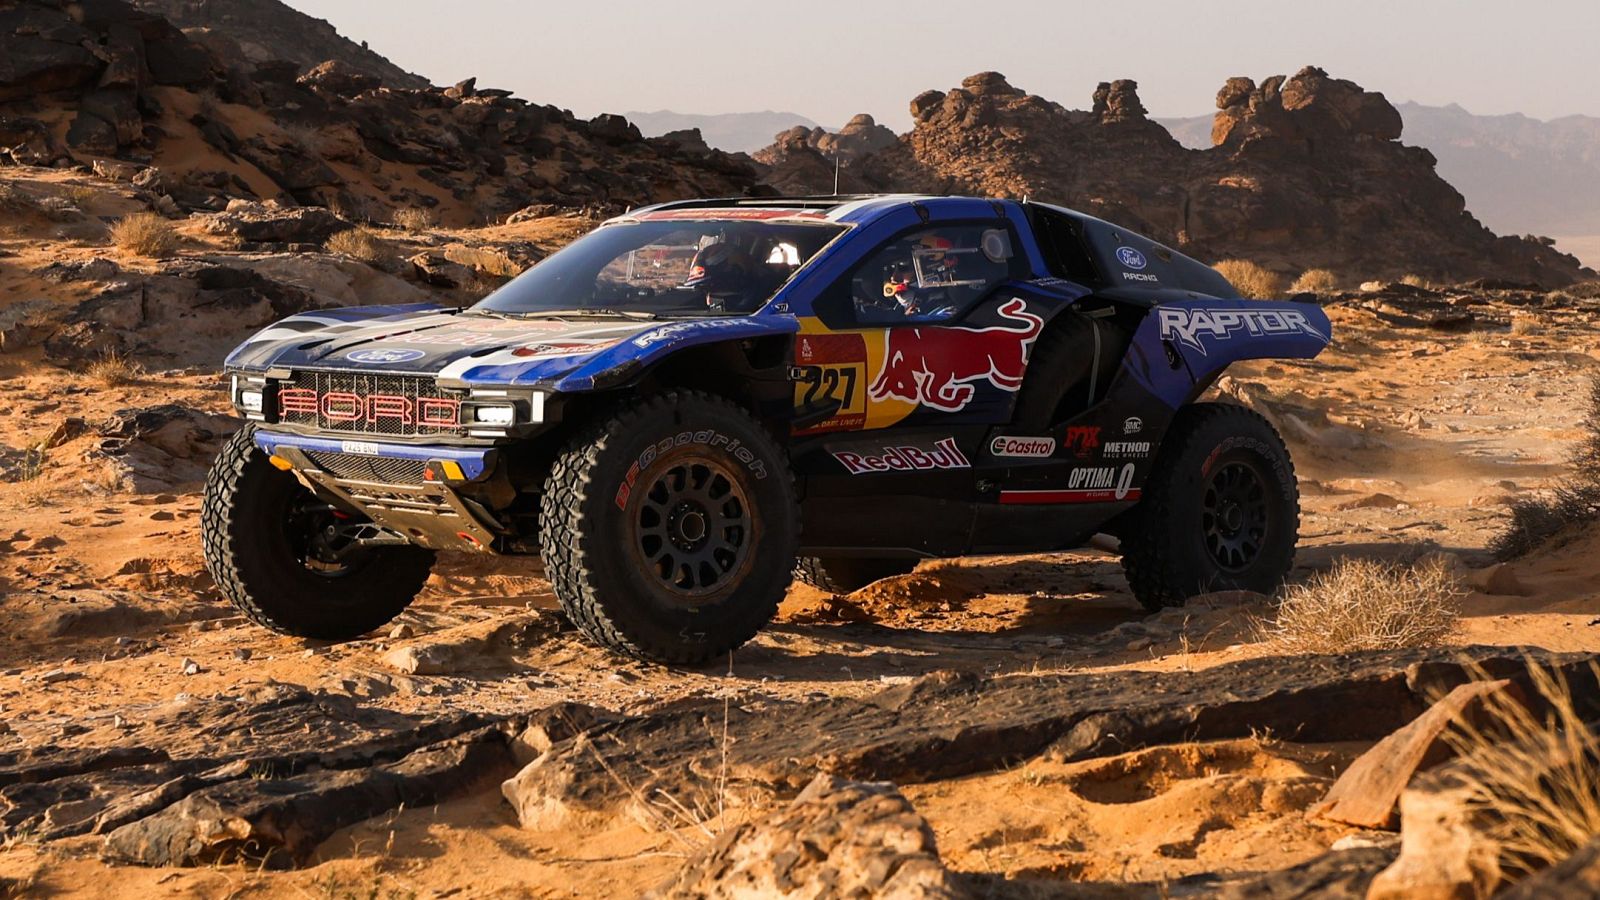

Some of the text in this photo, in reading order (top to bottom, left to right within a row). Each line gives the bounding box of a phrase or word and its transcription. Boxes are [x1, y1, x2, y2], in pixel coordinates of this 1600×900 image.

[1122, 249, 1142, 265] Ford
[1122, 272, 1158, 282] RACING
[632, 318, 768, 349] RAPTOR
[1158, 306, 1329, 357] RAPTOR
[797, 366, 857, 410] 227
[278, 388, 460, 428] FORD
[1006, 439, 1053, 454] Castrol
[1104, 442, 1150, 453] METHOD
[615, 429, 767, 512] BFGoodrich
[1067, 467, 1115, 489] OPTIMA
